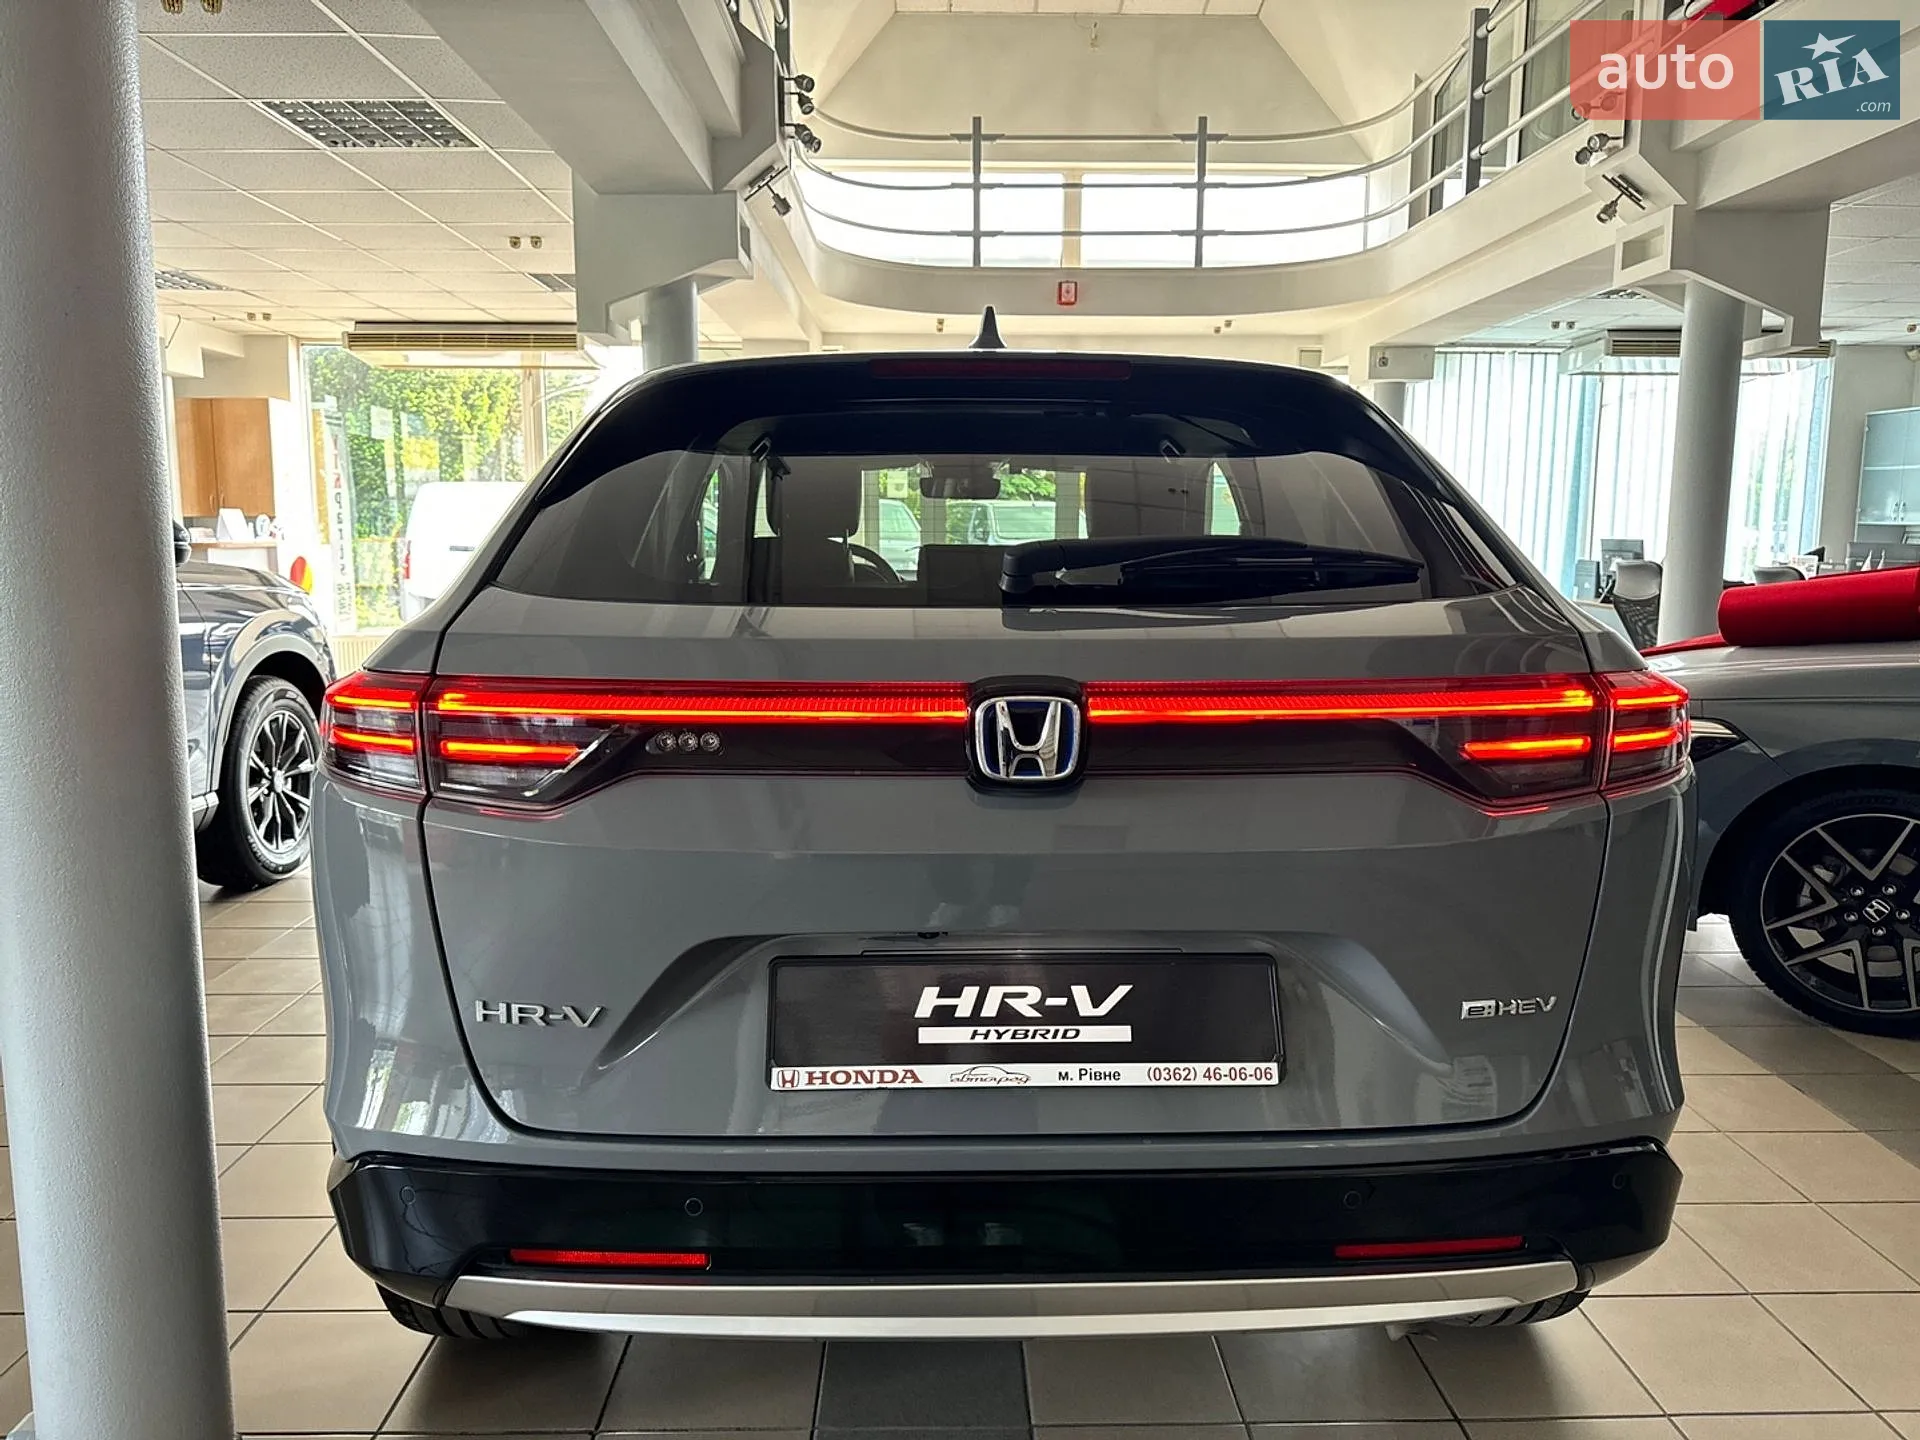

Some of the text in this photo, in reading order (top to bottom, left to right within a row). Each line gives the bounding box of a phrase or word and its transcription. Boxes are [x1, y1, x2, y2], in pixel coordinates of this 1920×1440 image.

[914, 984, 1134, 1018] HR-V
[475, 999, 605, 1028] HR-V
[969, 1028, 1081, 1041] HYBRID
[804, 1068, 923, 1086] HONDA
[1057, 1066, 1274, 1082] м. Рівне (0362) 46-06-06
